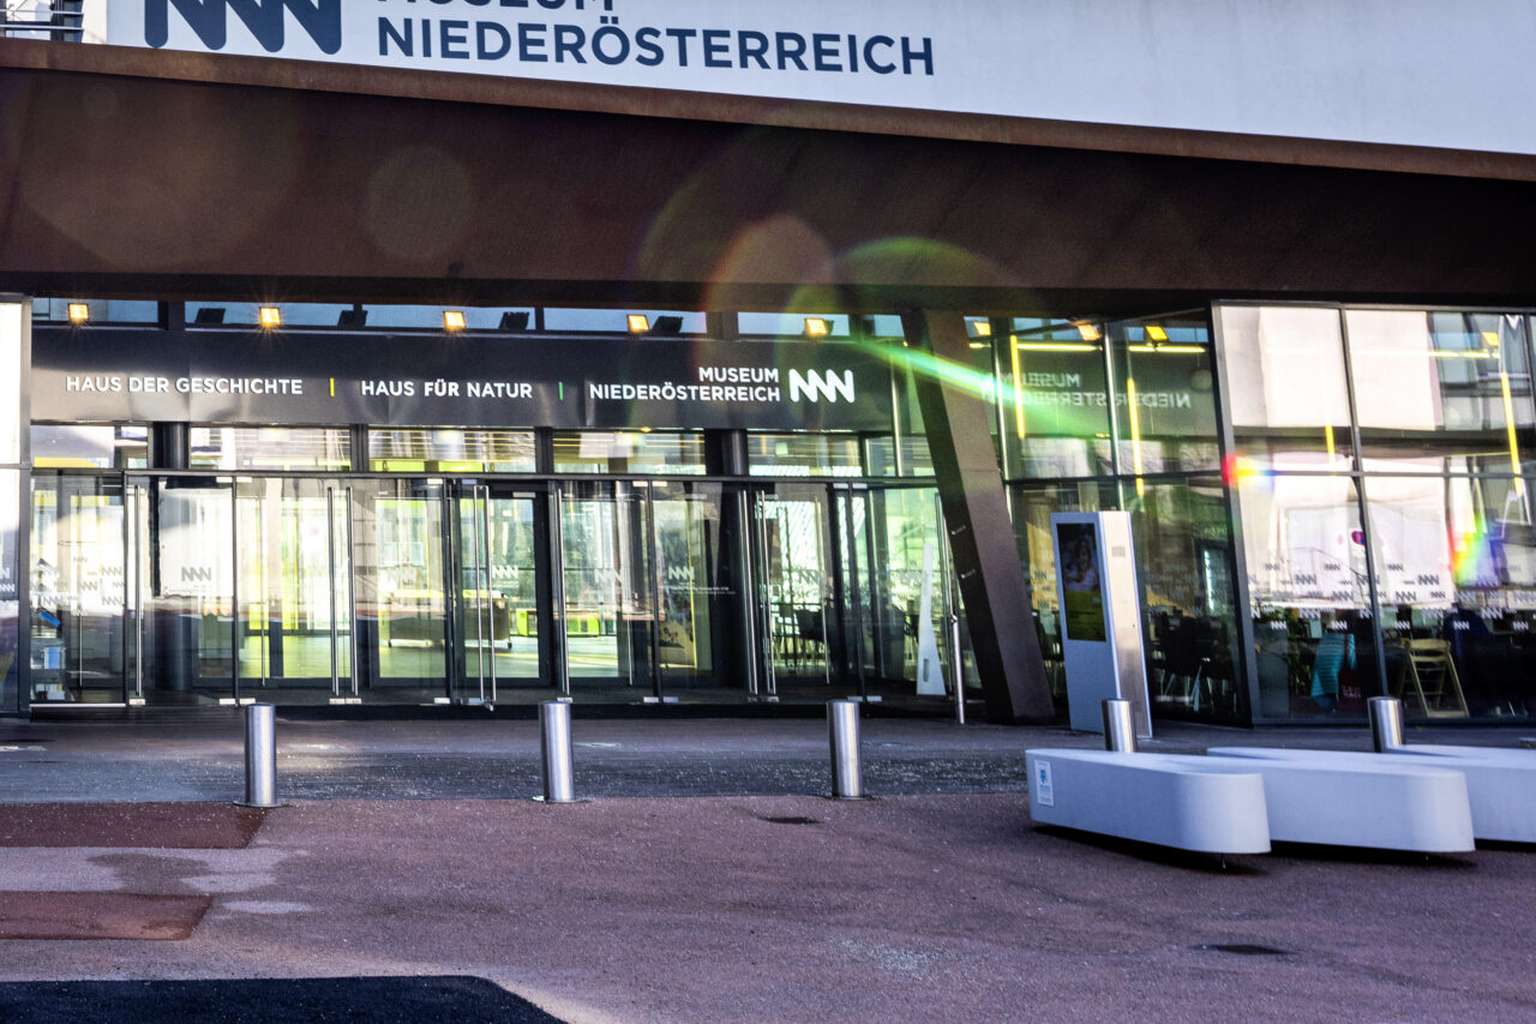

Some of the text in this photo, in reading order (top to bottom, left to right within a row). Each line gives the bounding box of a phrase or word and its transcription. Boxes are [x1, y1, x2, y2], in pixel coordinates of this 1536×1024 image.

[377, 15, 935, 77] NIEDERÖSTERREICH
[66, 376, 303, 394] HAUS DER GESCHICHTE
[698, 367, 780, 384] MUSEUM
[361, 378, 533, 398] HAUS FÜR NATUR
[589, 381, 781, 402] NIEDERÖSTERREICH
